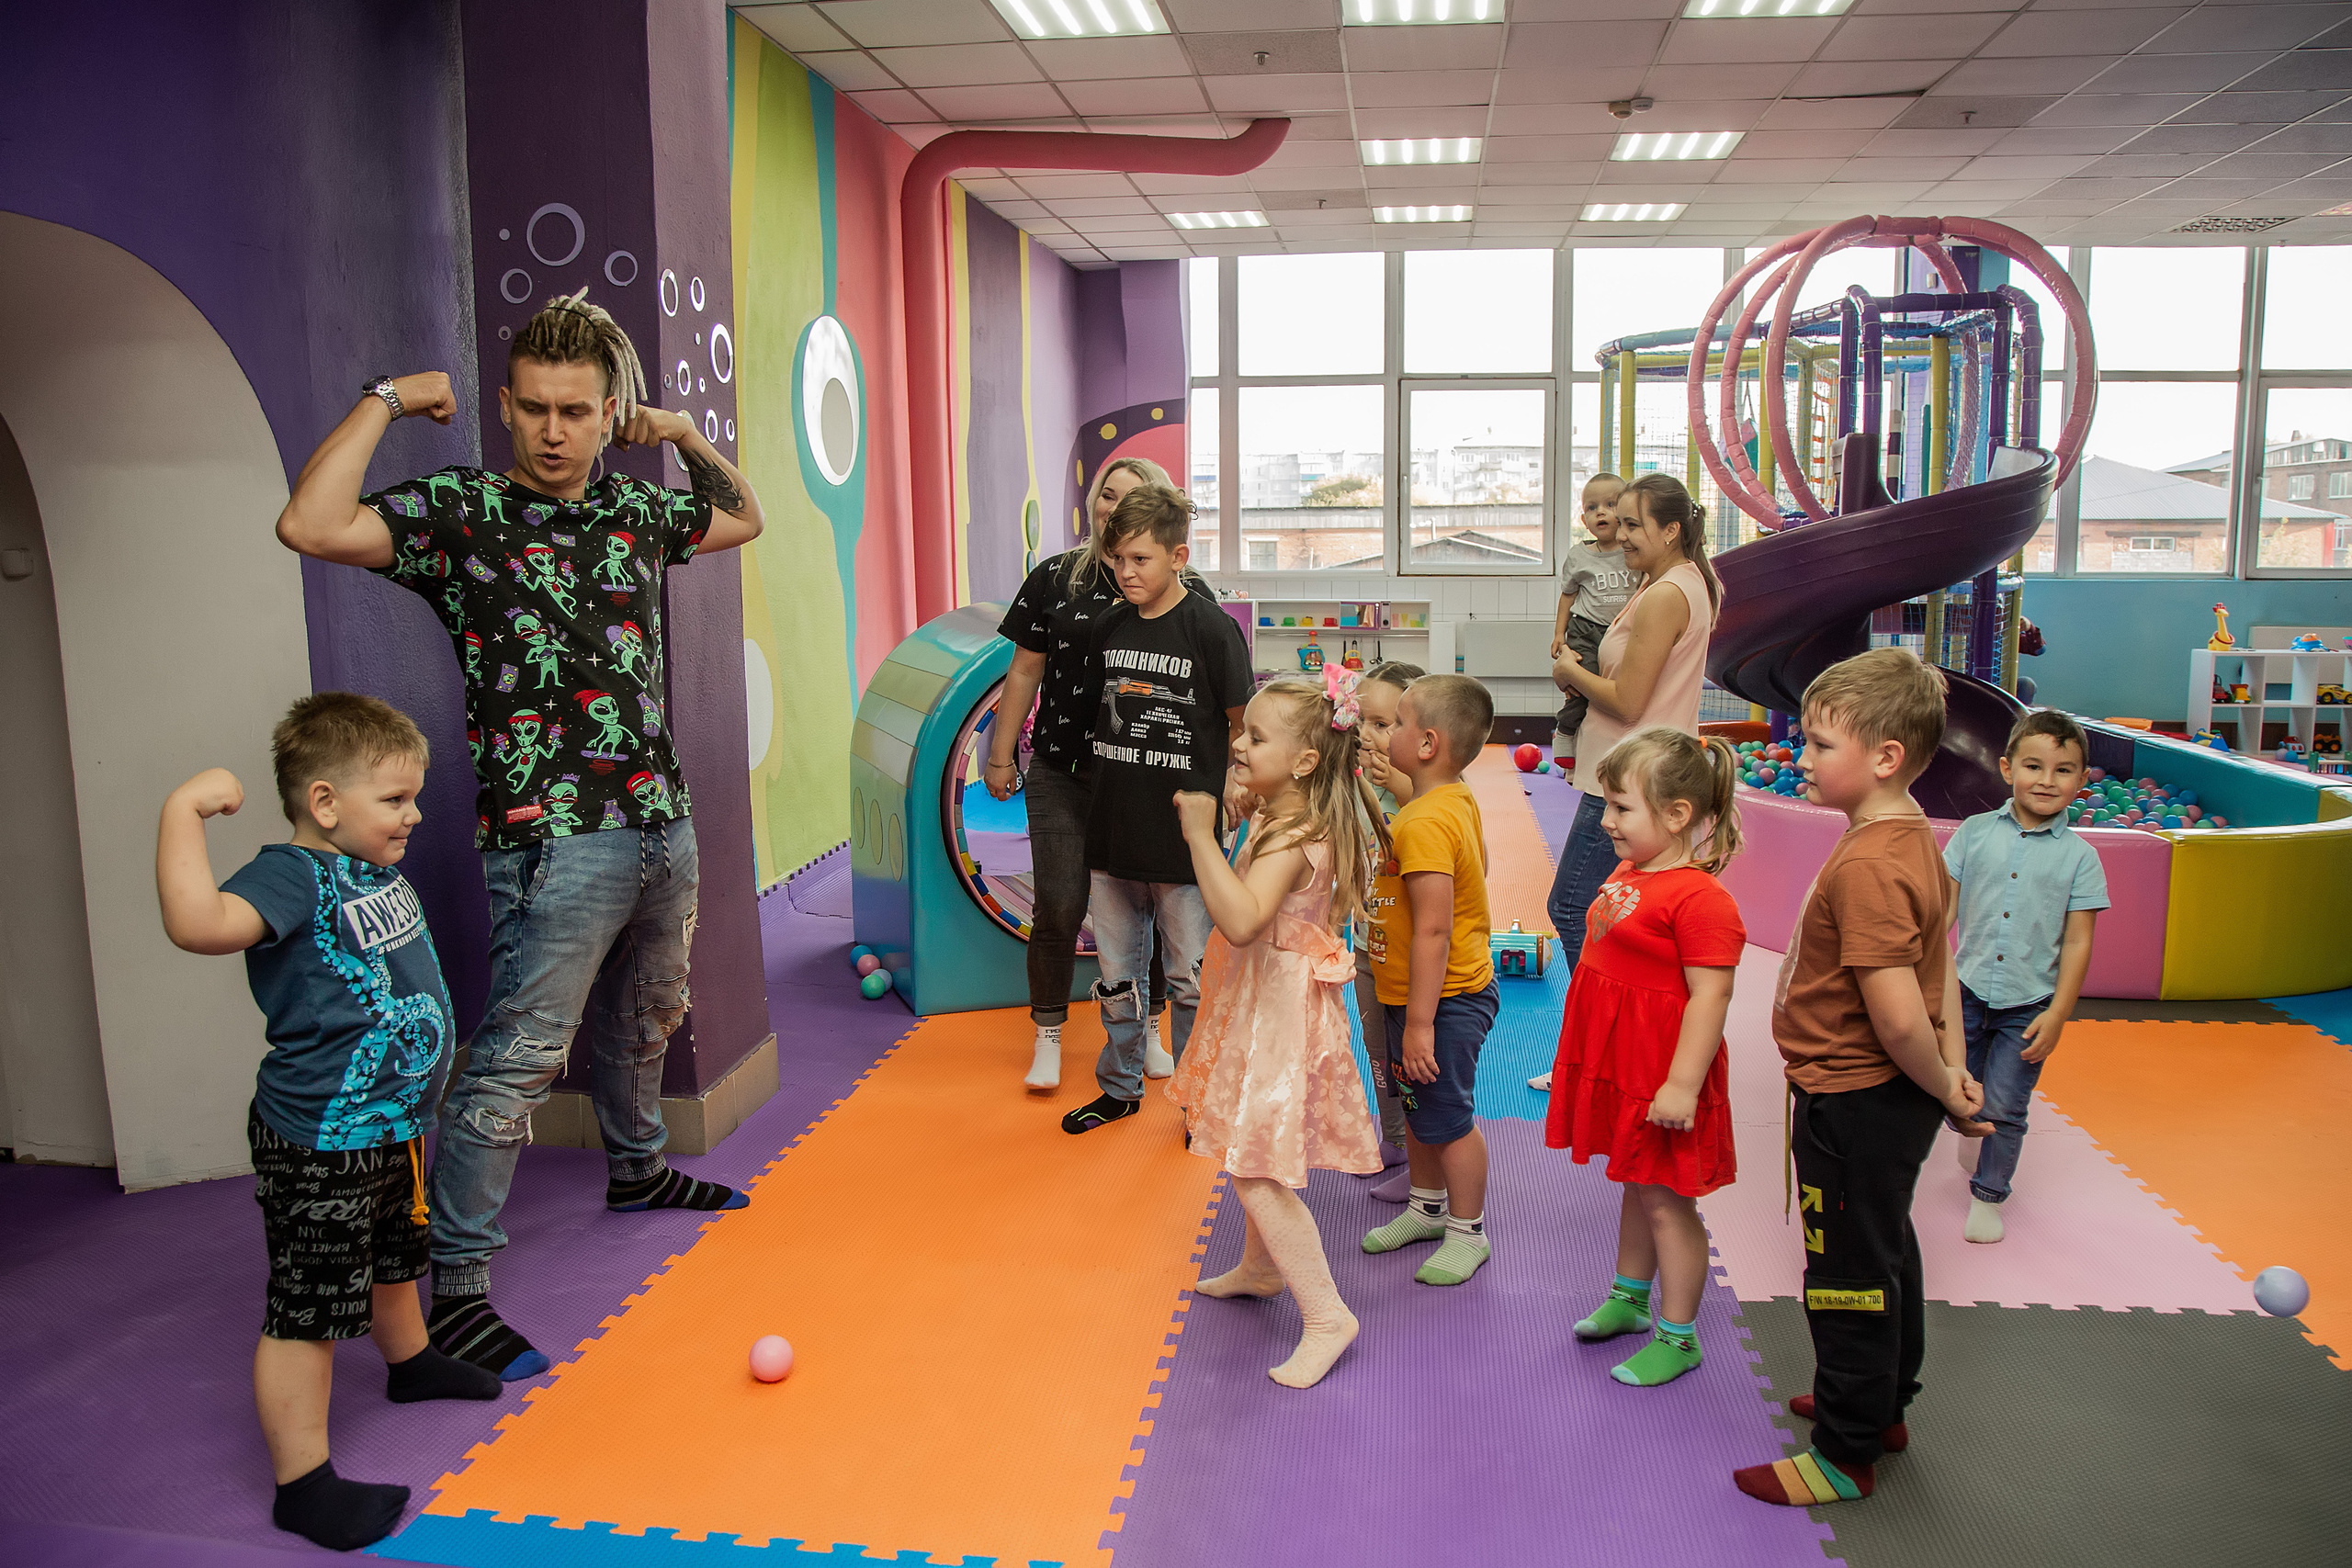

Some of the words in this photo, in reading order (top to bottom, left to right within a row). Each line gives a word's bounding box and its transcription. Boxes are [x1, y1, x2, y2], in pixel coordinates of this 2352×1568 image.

[1595, 570, 1631, 591] BOY
[1074, 612, 1090, 620] love
[1102, 649, 1193, 679] ЛАШНИКОВ
[1146, 750, 1192, 771] ОРУЖИЕ
[1372, 897, 1396, 908] TTLE
[353, 879, 419, 945] AWESO
[302, 1164, 329, 1178] Style
[298, 1225, 328, 1239] NYC
[329, 1255, 361, 1264] VIBES
[1809, 1295, 1823, 1304] F/W
[1868, 1295, 1881, 1304] 700
[332, 1299, 368, 1316] RULES
